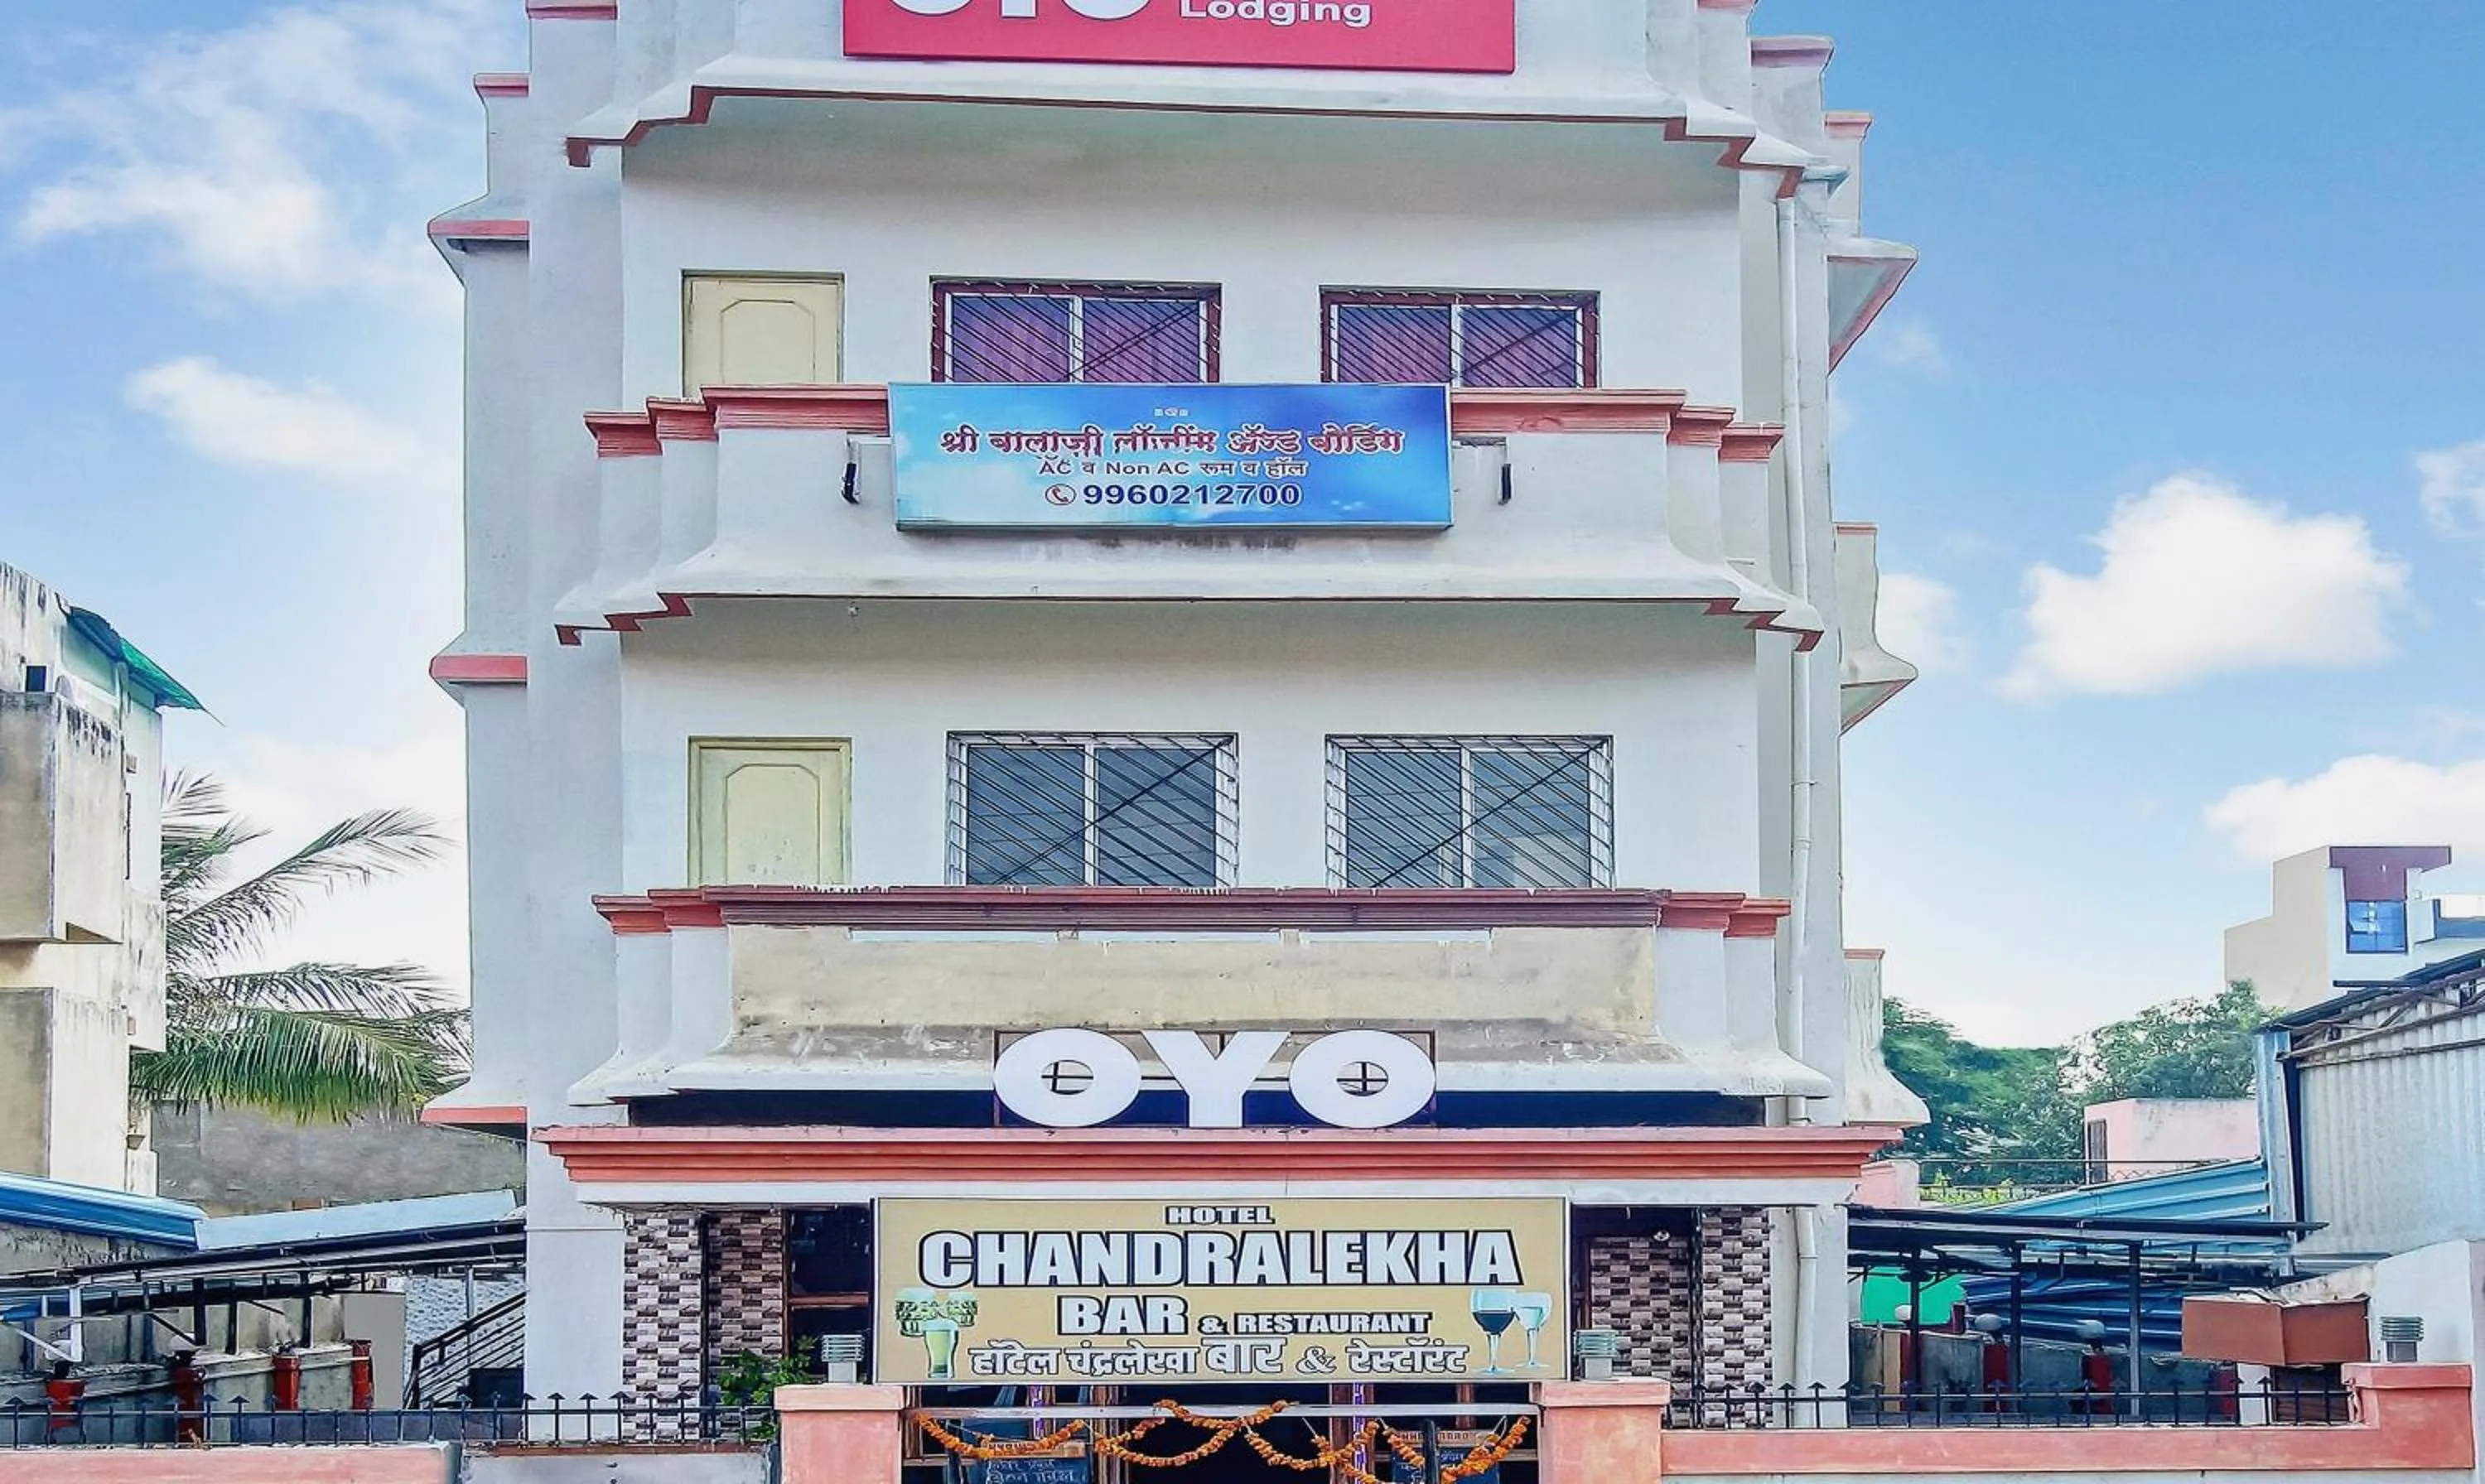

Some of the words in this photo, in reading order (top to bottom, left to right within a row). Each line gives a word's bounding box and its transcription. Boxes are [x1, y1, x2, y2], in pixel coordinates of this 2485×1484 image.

[1180, 0, 1372, 27] Lodging
[940, 425, 980, 454] श्री
[1039, 460, 1072, 475] AC
[1081, 460, 1095, 475] व
[1105, 460, 1151, 475] Non
[1157, 460, 1189, 475] AC
[1199, 460, 1235, 476] रूम
[1242, 460, 1259, 475] व
[1267, 455, 1307, 478] हॉल
[1083, 483, 1300, 505] 9960212700
[993, 1028, 1437, 1128] OYO
[1165, 1205, 1274, 1225] HOTEL
[919, 1231, 1522, 1288] CHANDRALEKHA
[1059, 1294, 1188, 1336] BAR
[1199, 1314, 1229, 1335] &
[1234, 1312, 1432, 1334] RESTAURANT
[1064, 1339, 1200, 1376] चंद्रलेखा
[1201, 1336, 1287, 1373] बार
[1296, 1346, 1336, 1373] &
[1345, 1336, 1469, 1373] रेस्टॉरंट
